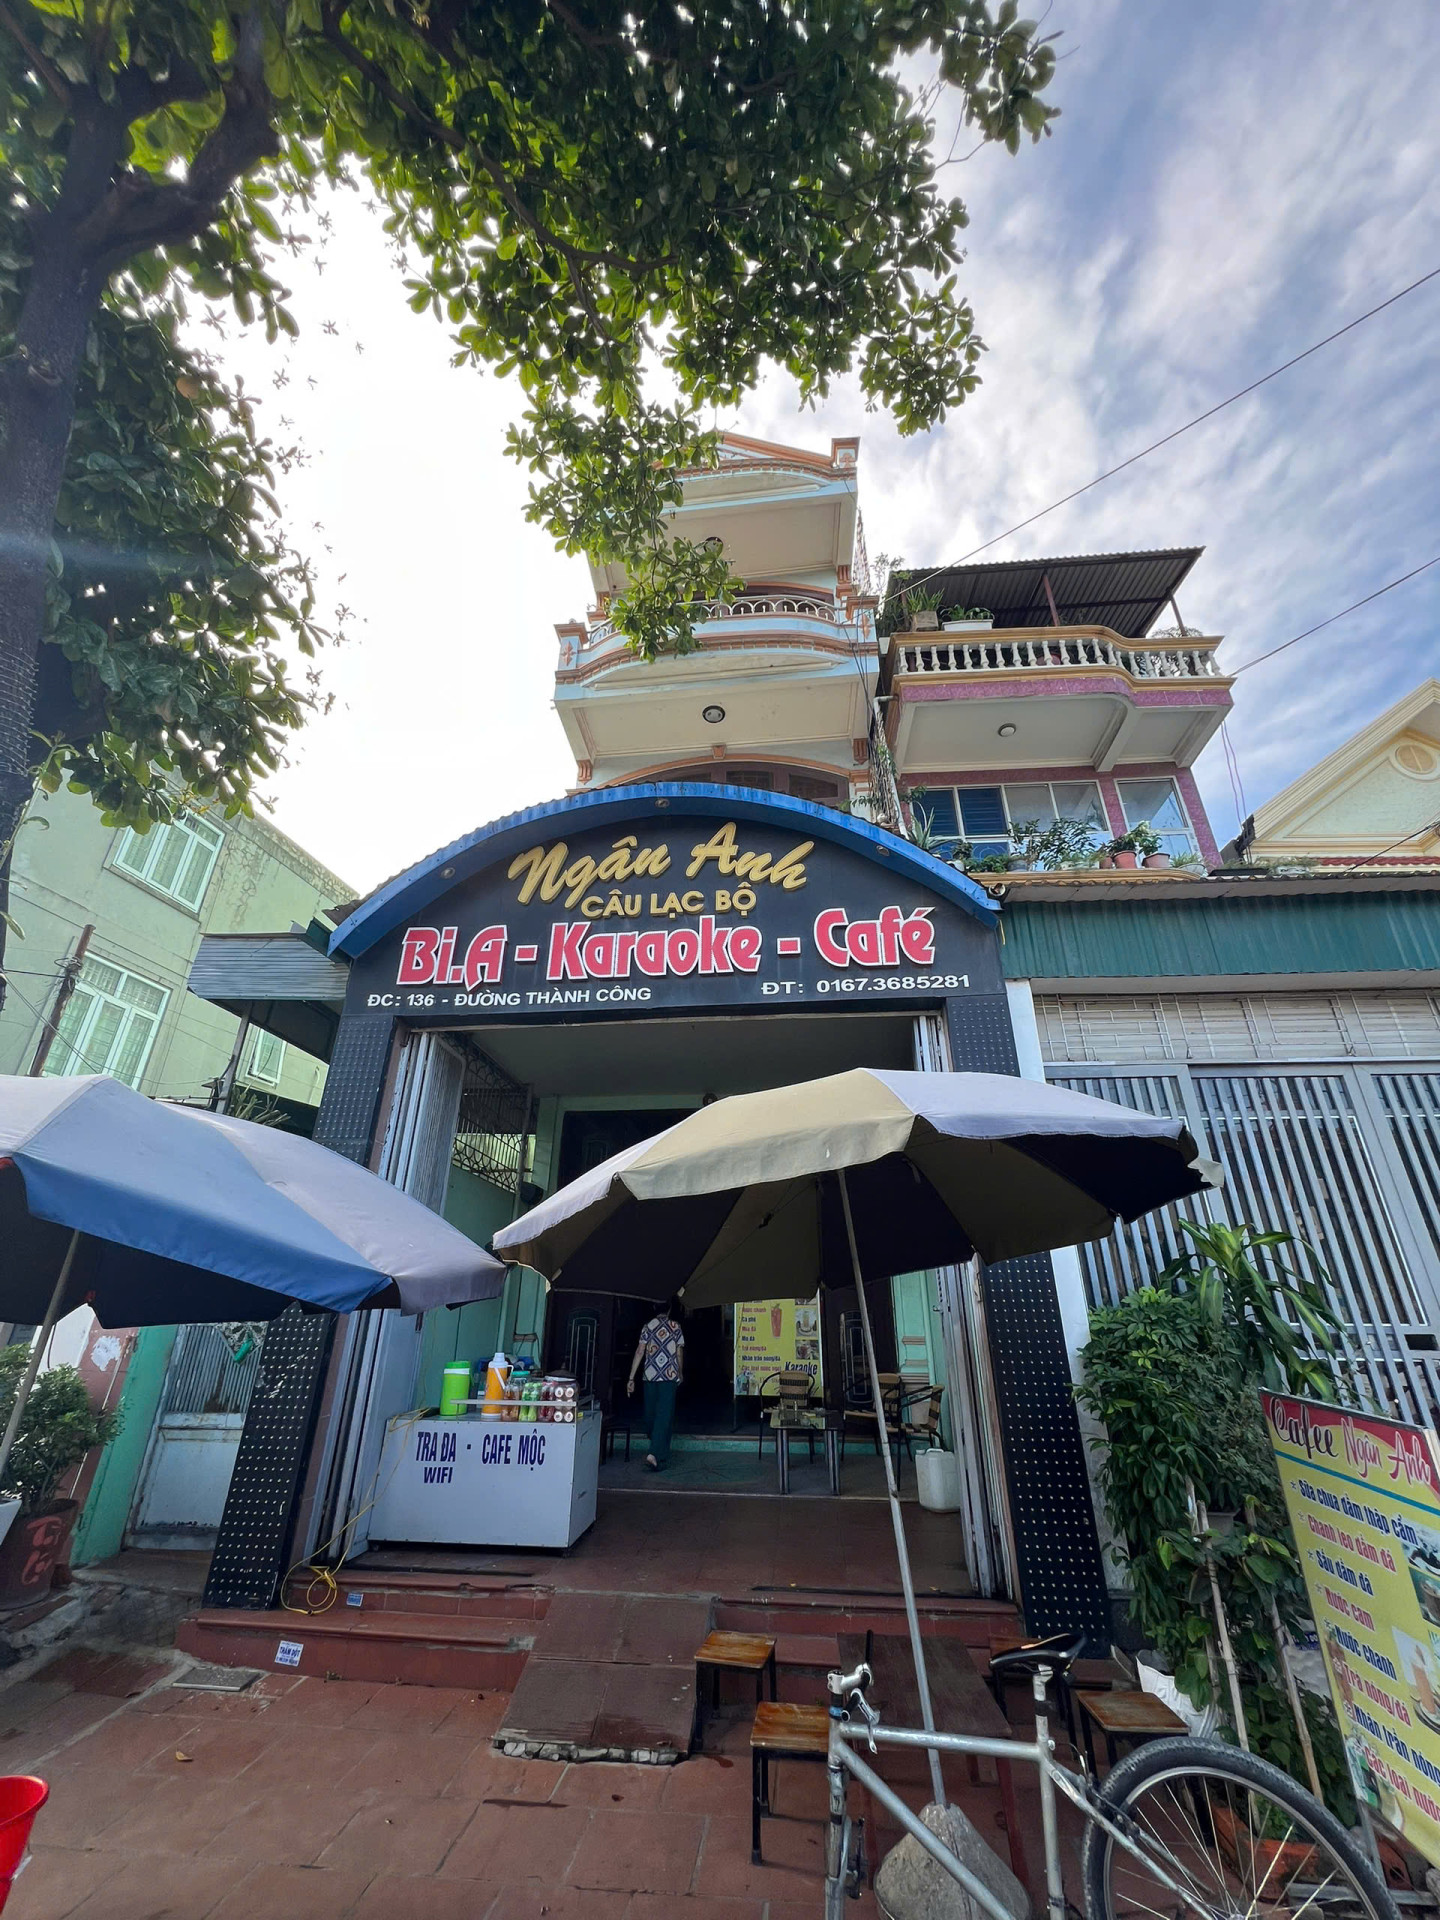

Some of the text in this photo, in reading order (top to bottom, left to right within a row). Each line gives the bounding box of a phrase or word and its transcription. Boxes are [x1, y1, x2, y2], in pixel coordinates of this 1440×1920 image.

[508, 822, 814, 908] Ngân Anh
[581, 882, 757, 919] CÂU LẠC BỘ
[546, 915, 762, 980] Karaoke
[814, 906, 935, 967] Café
[367, 993, 402, 1007] ĐC:
[407, 993, 434, 1007] 136
[454, 989, 521, 1007] ĐƯỜNG
[525, 986, 590, 1004] THÀNH
[595, 985, 652, 1002] CÔNG
[761, 974, 970, 995] ĐT: 0167.3685281
[482, 1434, 512, 1464] CAFE
[517, 1428, 546, 1471] MỘC
[1270, 1397, 1430, 1485] Cafee Ngân Anh
[424, 1467, 453, 1483] WIFI
[1299, 1480, 1316, 1501] Sữa
[1317, 1488, 1340, 1511] chua
[1337, 1527, 1354, 1551] leo
[1324, 1586, 1375, 1631] Nước cam
[1334, 1624, 1361, 1657] Nước
[1362, 1643, 1397, 1680] chanh
[1342, 1661, 1411, 1727] Trà nóng/đá
